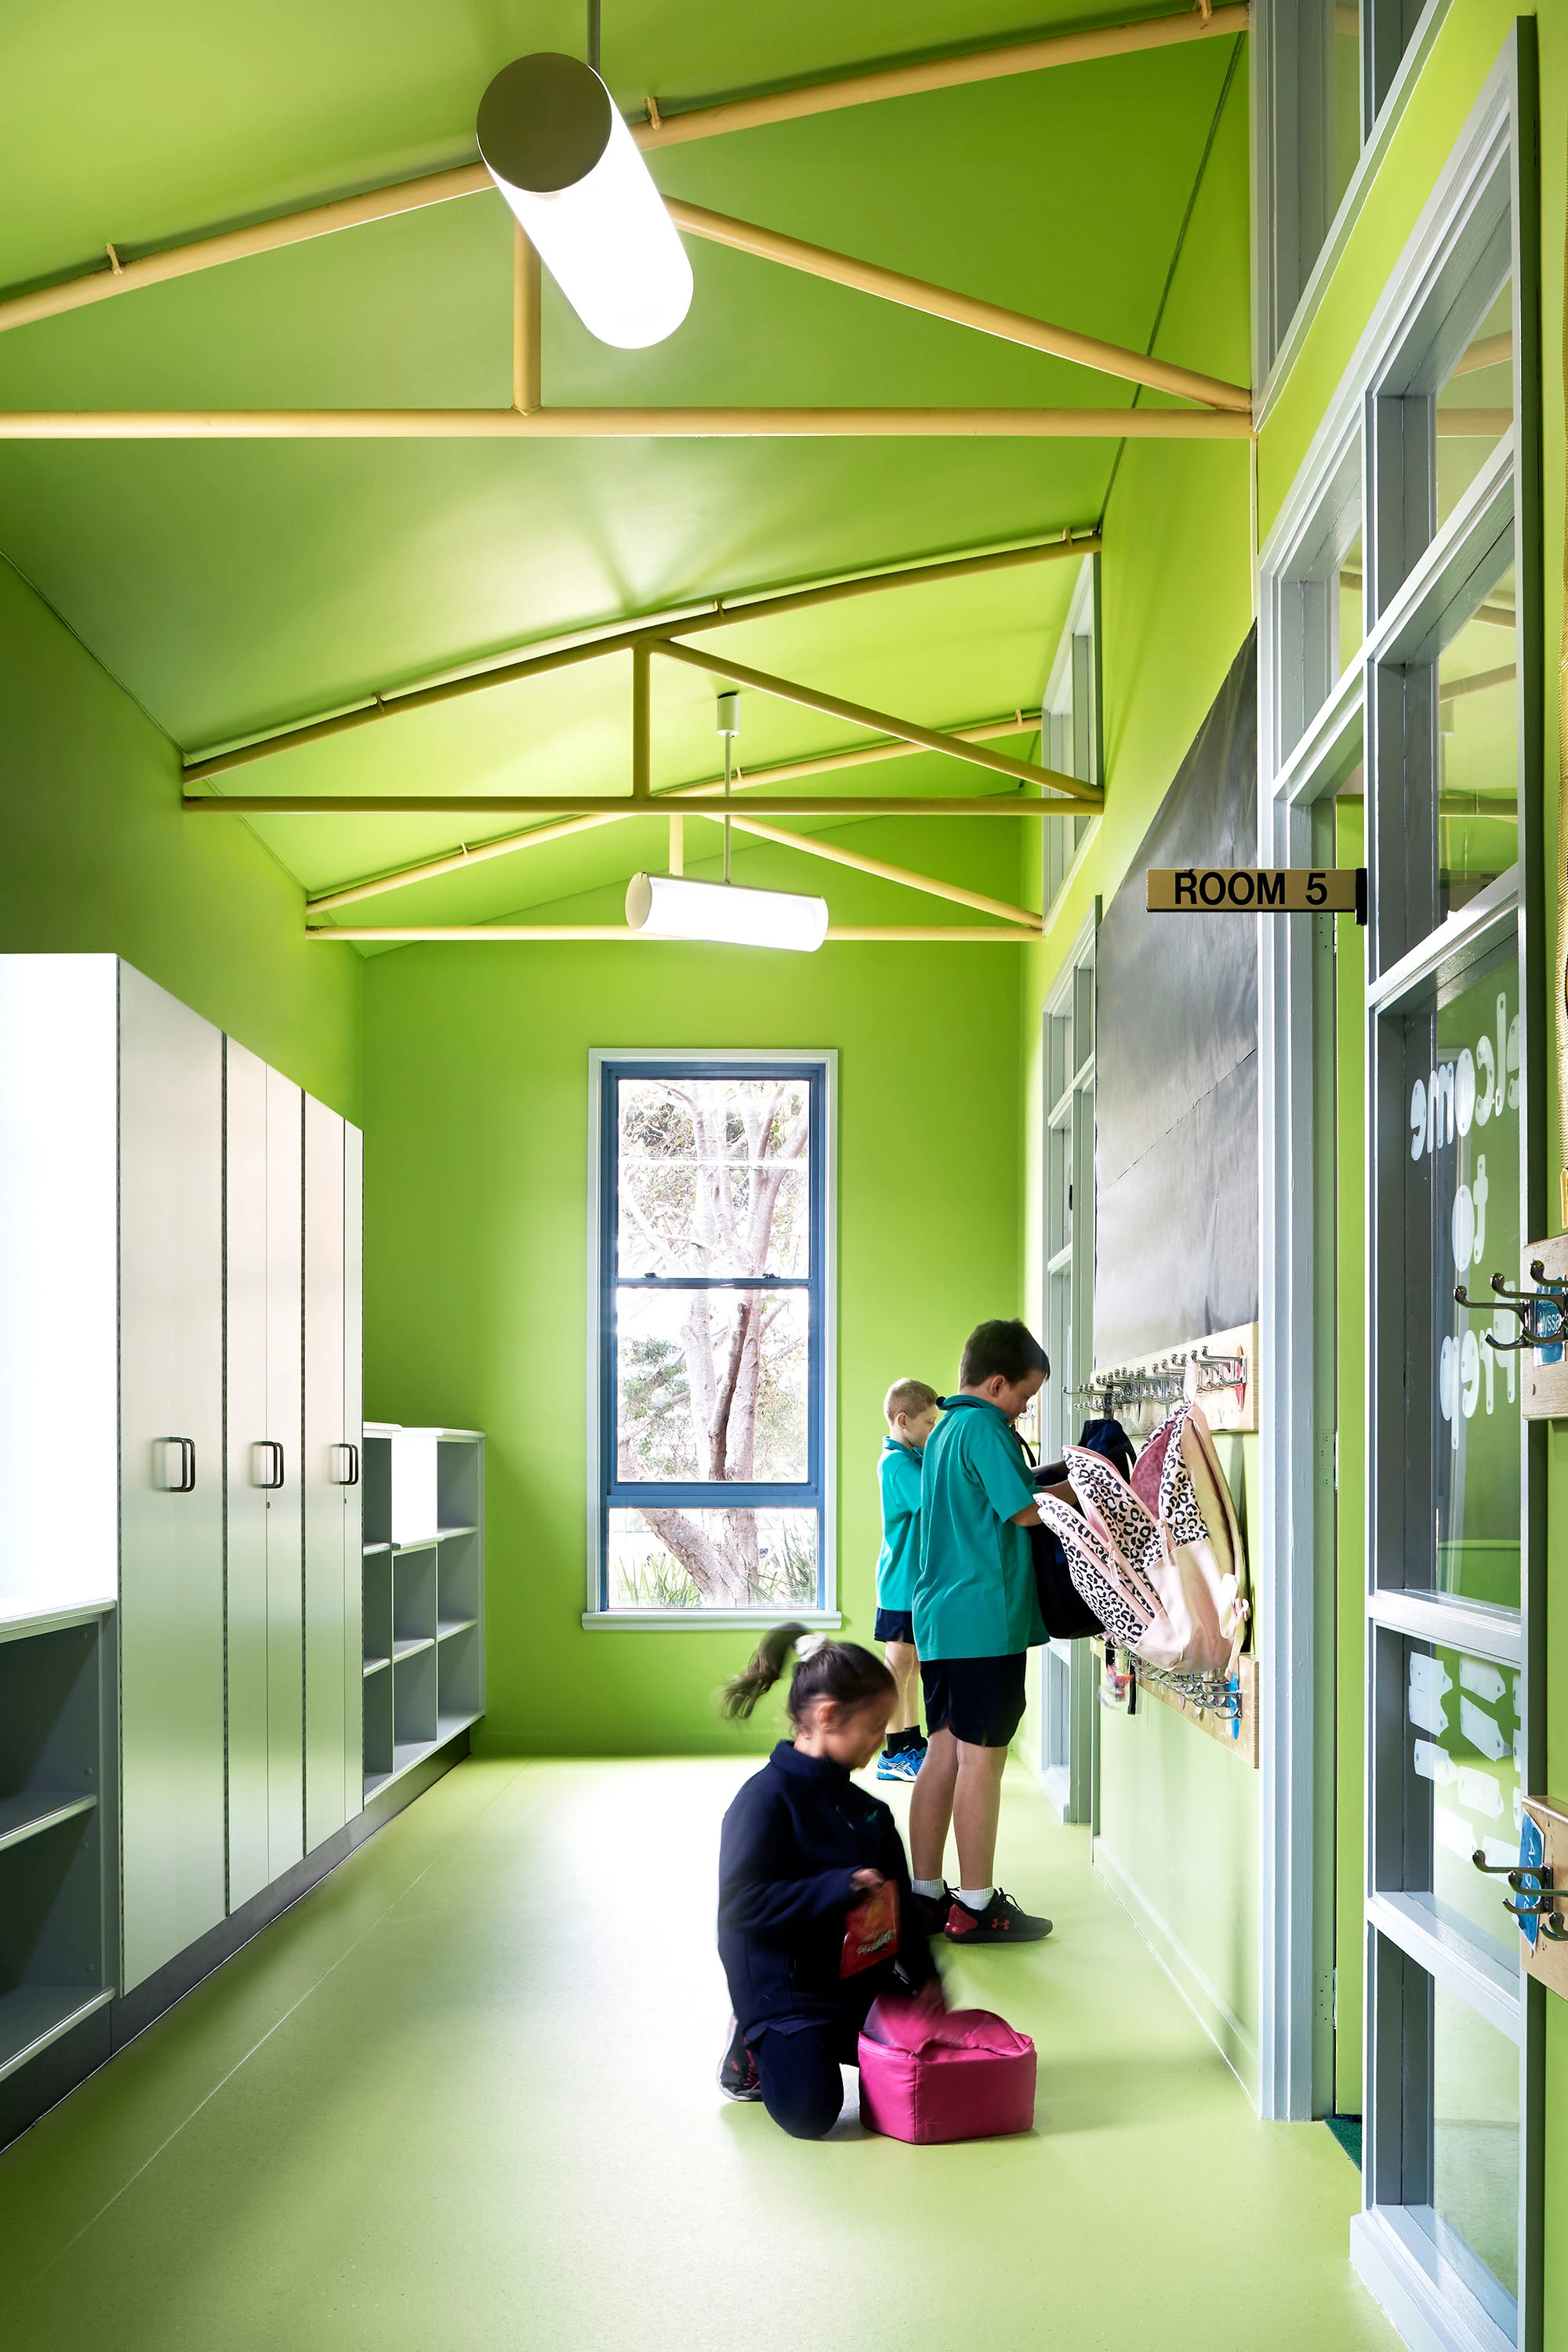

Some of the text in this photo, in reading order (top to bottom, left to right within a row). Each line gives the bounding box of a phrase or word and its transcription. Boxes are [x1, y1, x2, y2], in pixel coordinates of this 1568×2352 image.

[1174, 871, 1327, 906] ROOM 5
[1541, 1310, 1563, 1336] lyssa
